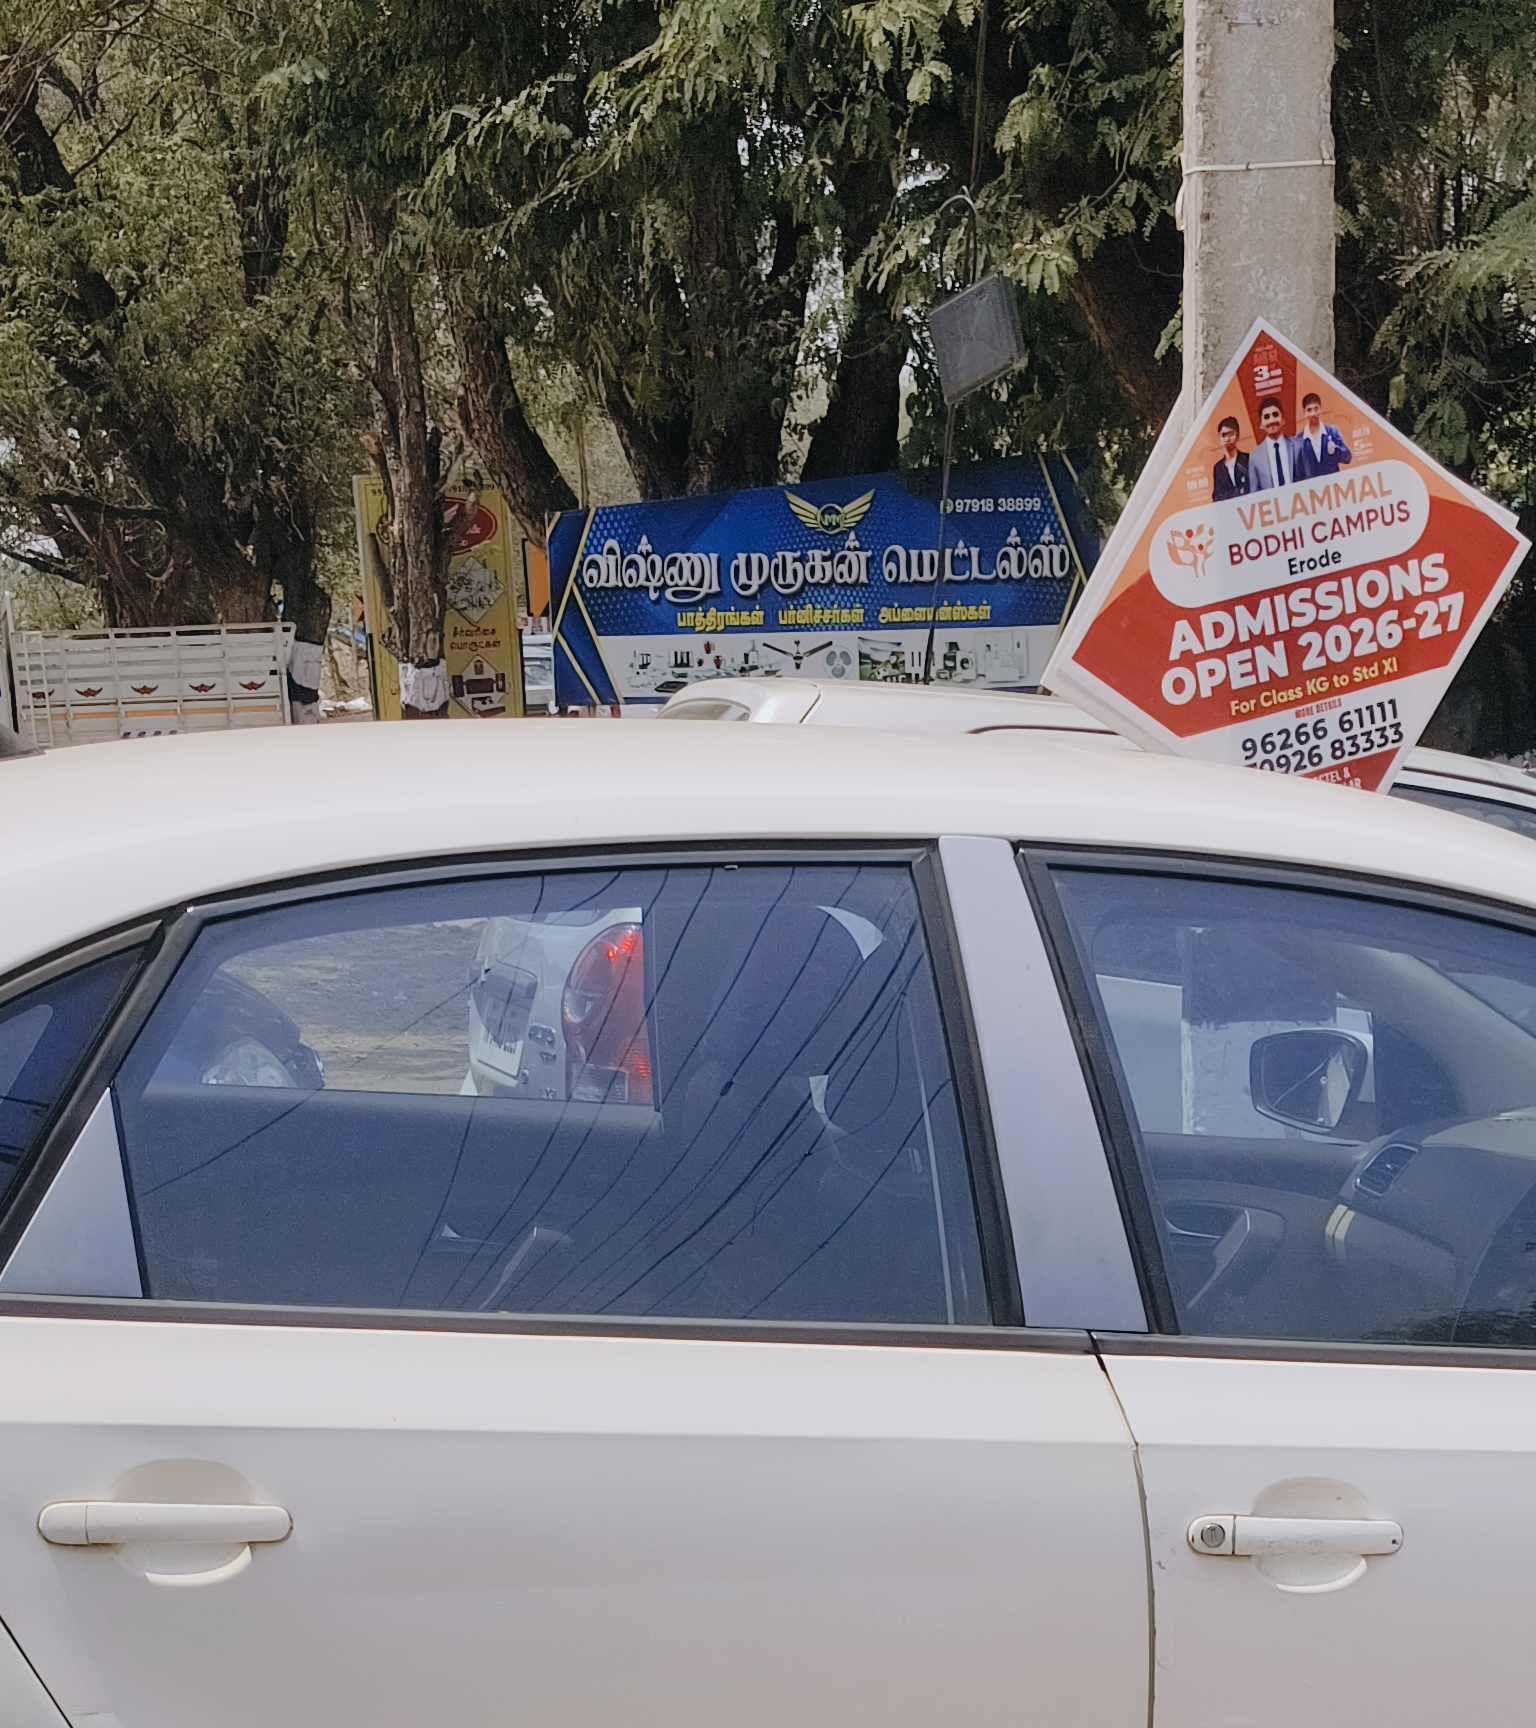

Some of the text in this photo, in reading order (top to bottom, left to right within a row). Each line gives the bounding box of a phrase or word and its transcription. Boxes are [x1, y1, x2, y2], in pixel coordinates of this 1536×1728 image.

[955, 497, 1041, 513] 97918 38899
[1236, 471, 1393, 531] VELAMMAL
[1228, 500, 1411, 566] BODHI CAMPUS
[1287, 549, 1342, 576] Erode
[582, 523, 1071, 604] விஷ்ணு முருகன் மெட்டல்ஸ்
[676, 606, 765, 632] பாத்திரங்கள்
[778, 604, 865, 627] பர்னிச்சர்கள்
[1168, 553, 1449, 661] ADMISSIONS
[1161, 591, 1465, 706] OPEN 2026-27
[1229, 656, 1399, 716] For Class KG to Std XI
[1241, 698, 1399, 760] 96266 61111
[1330, 721, 1404, 760] 83333
